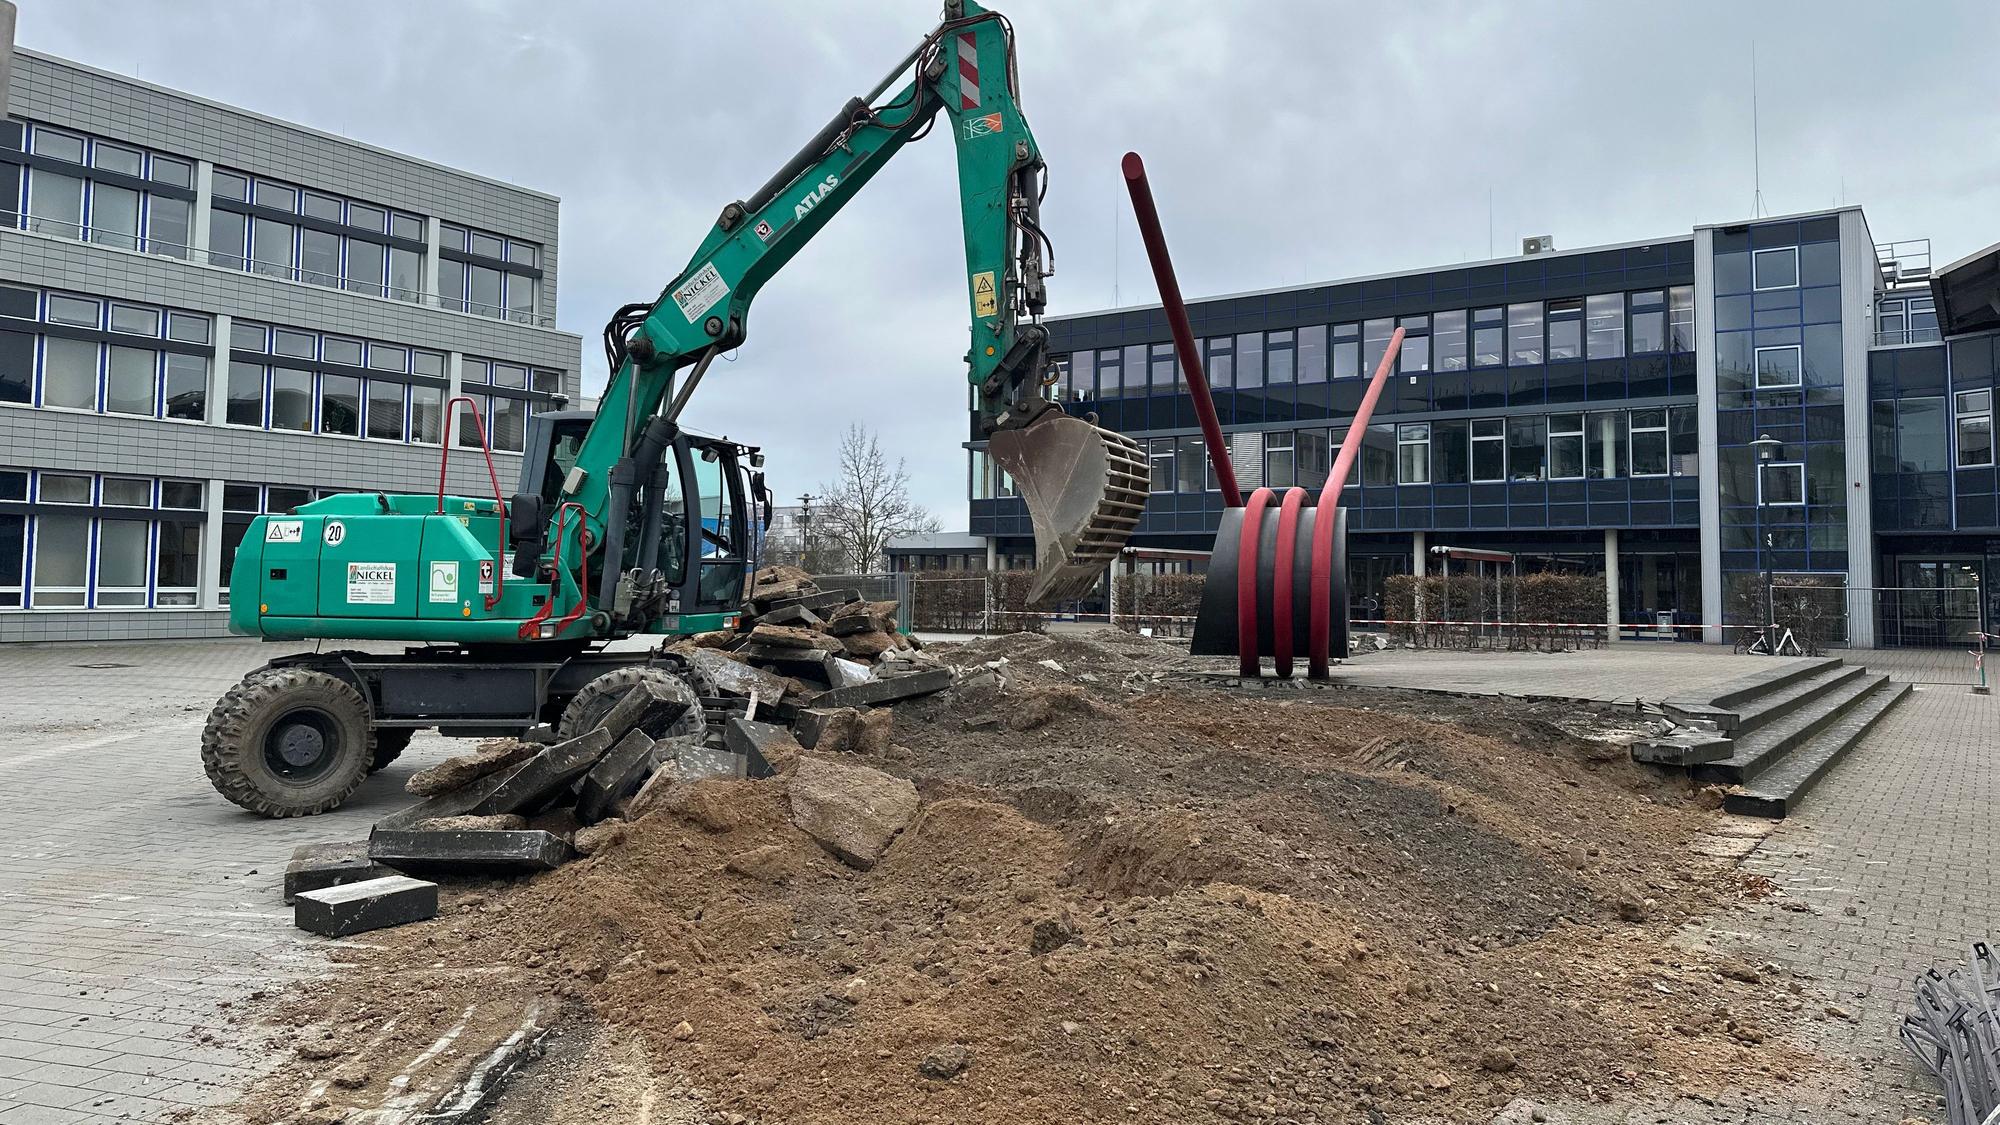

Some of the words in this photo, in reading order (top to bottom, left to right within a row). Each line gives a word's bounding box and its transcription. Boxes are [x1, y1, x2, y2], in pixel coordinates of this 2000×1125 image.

[795, 174, 838, 221] ATLAS
[683, 271, 717, 300] NICKEL
[328, 525, 341, 541] 20
[357, 571, 394, 580] NICKEL
